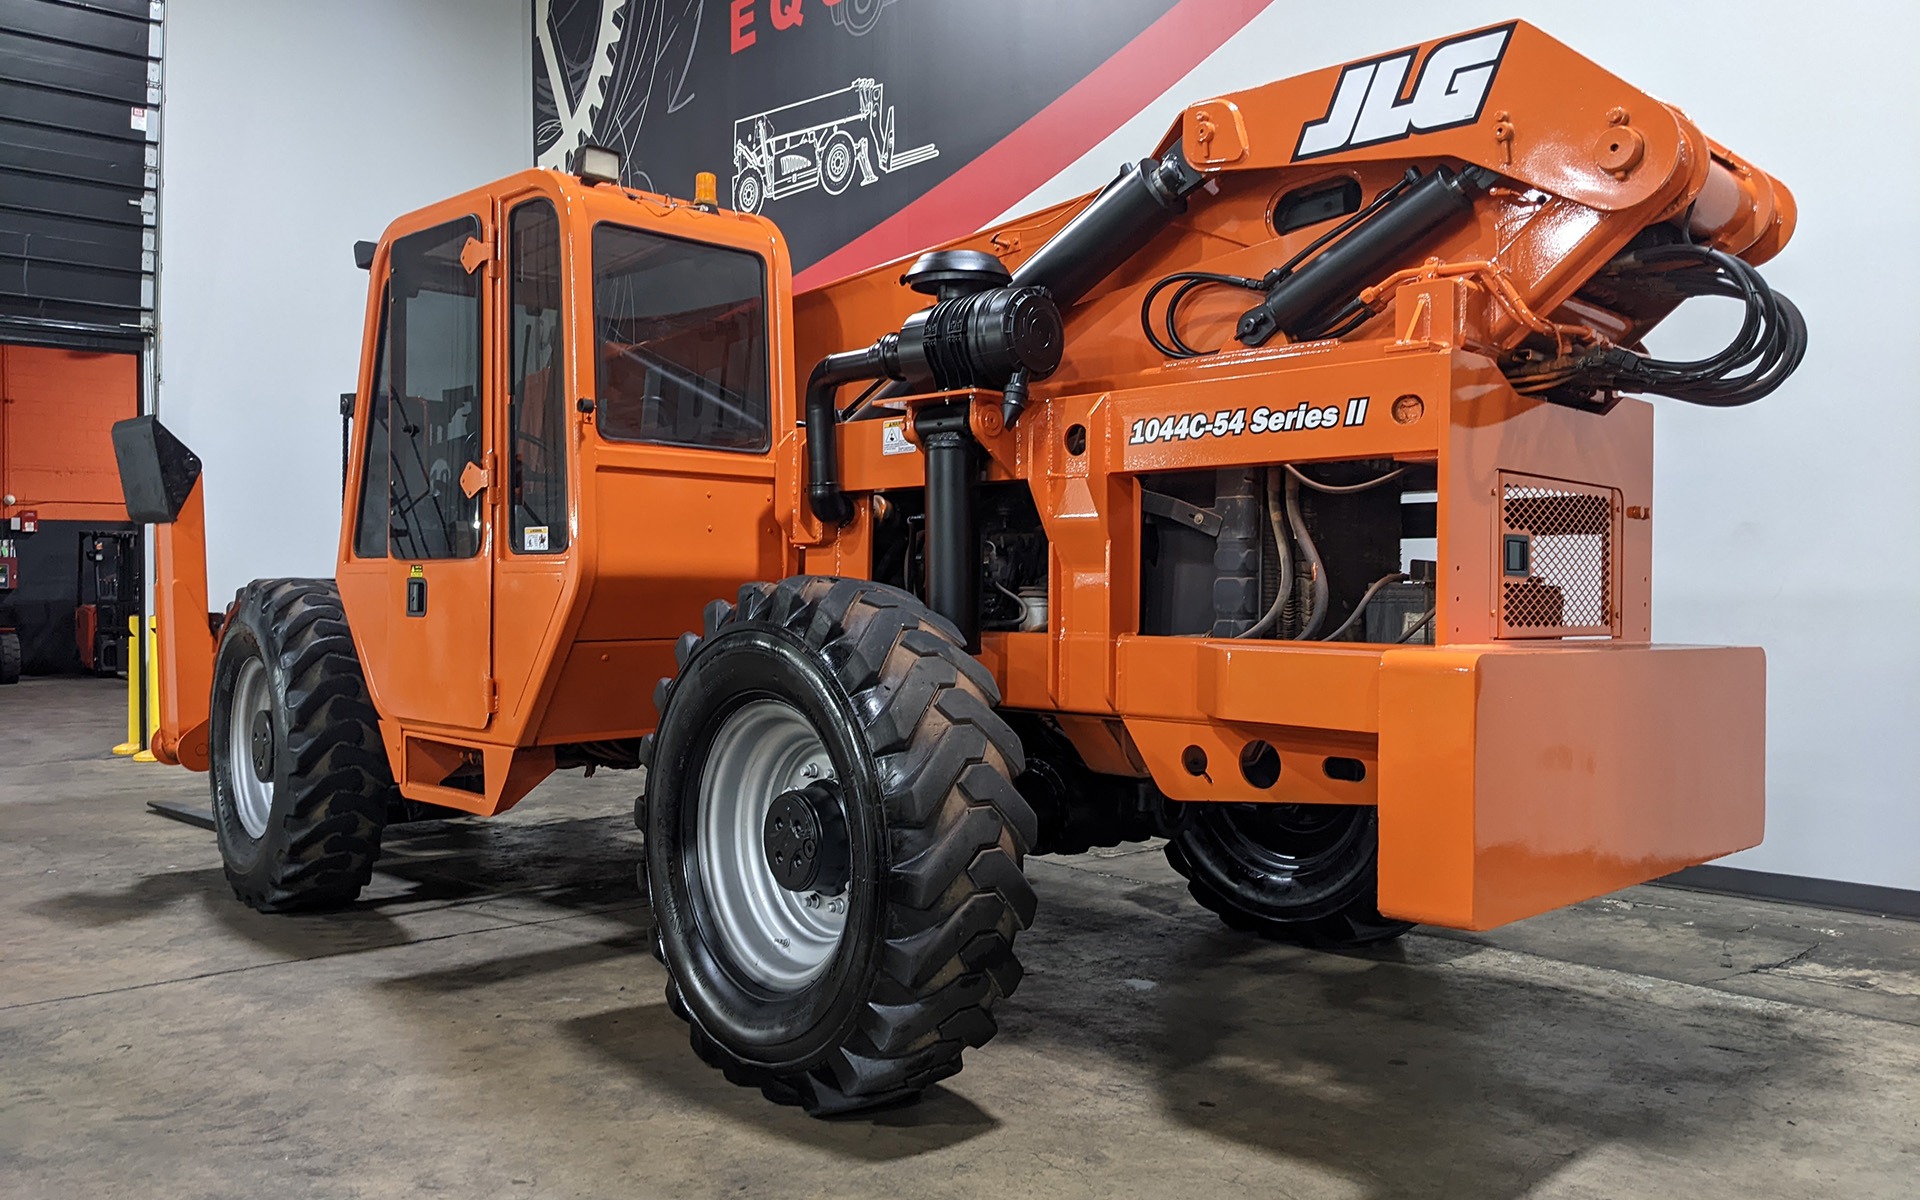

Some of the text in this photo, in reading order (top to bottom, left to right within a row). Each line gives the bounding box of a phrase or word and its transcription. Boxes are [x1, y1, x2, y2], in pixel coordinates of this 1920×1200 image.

[1291, 22, 1517, 162] JLG
[1129, 408, 1247, 444] 1044C-54
[1249, 403, 1339, 433] Series
